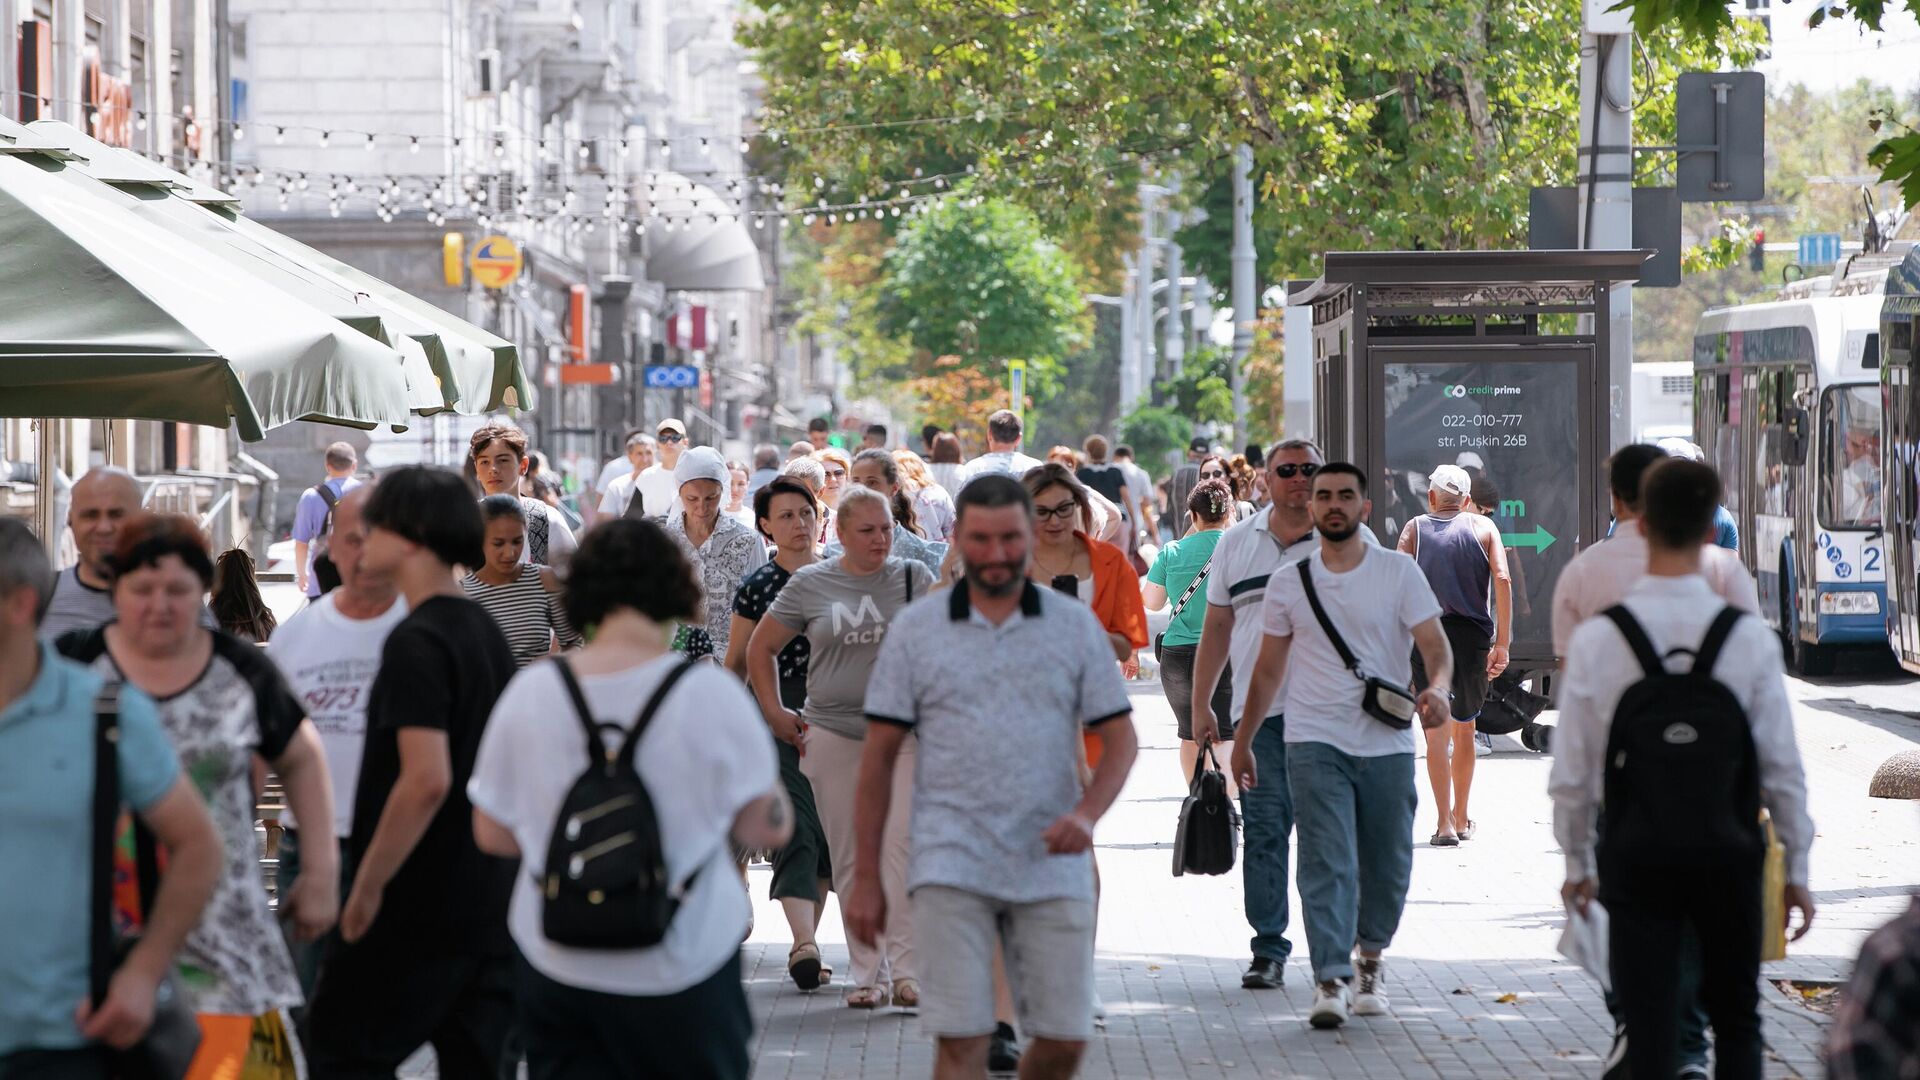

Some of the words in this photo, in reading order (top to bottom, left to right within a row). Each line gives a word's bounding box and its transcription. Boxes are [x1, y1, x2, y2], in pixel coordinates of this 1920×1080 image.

[1442, 414, 1523, 427] 022-010-777
[1438, 435, 1456, 447] str.
[1503, 434, 1527, 447] 26B
[1863, 546, 1880, 571] 2
[832, 595, 885, 637] M
